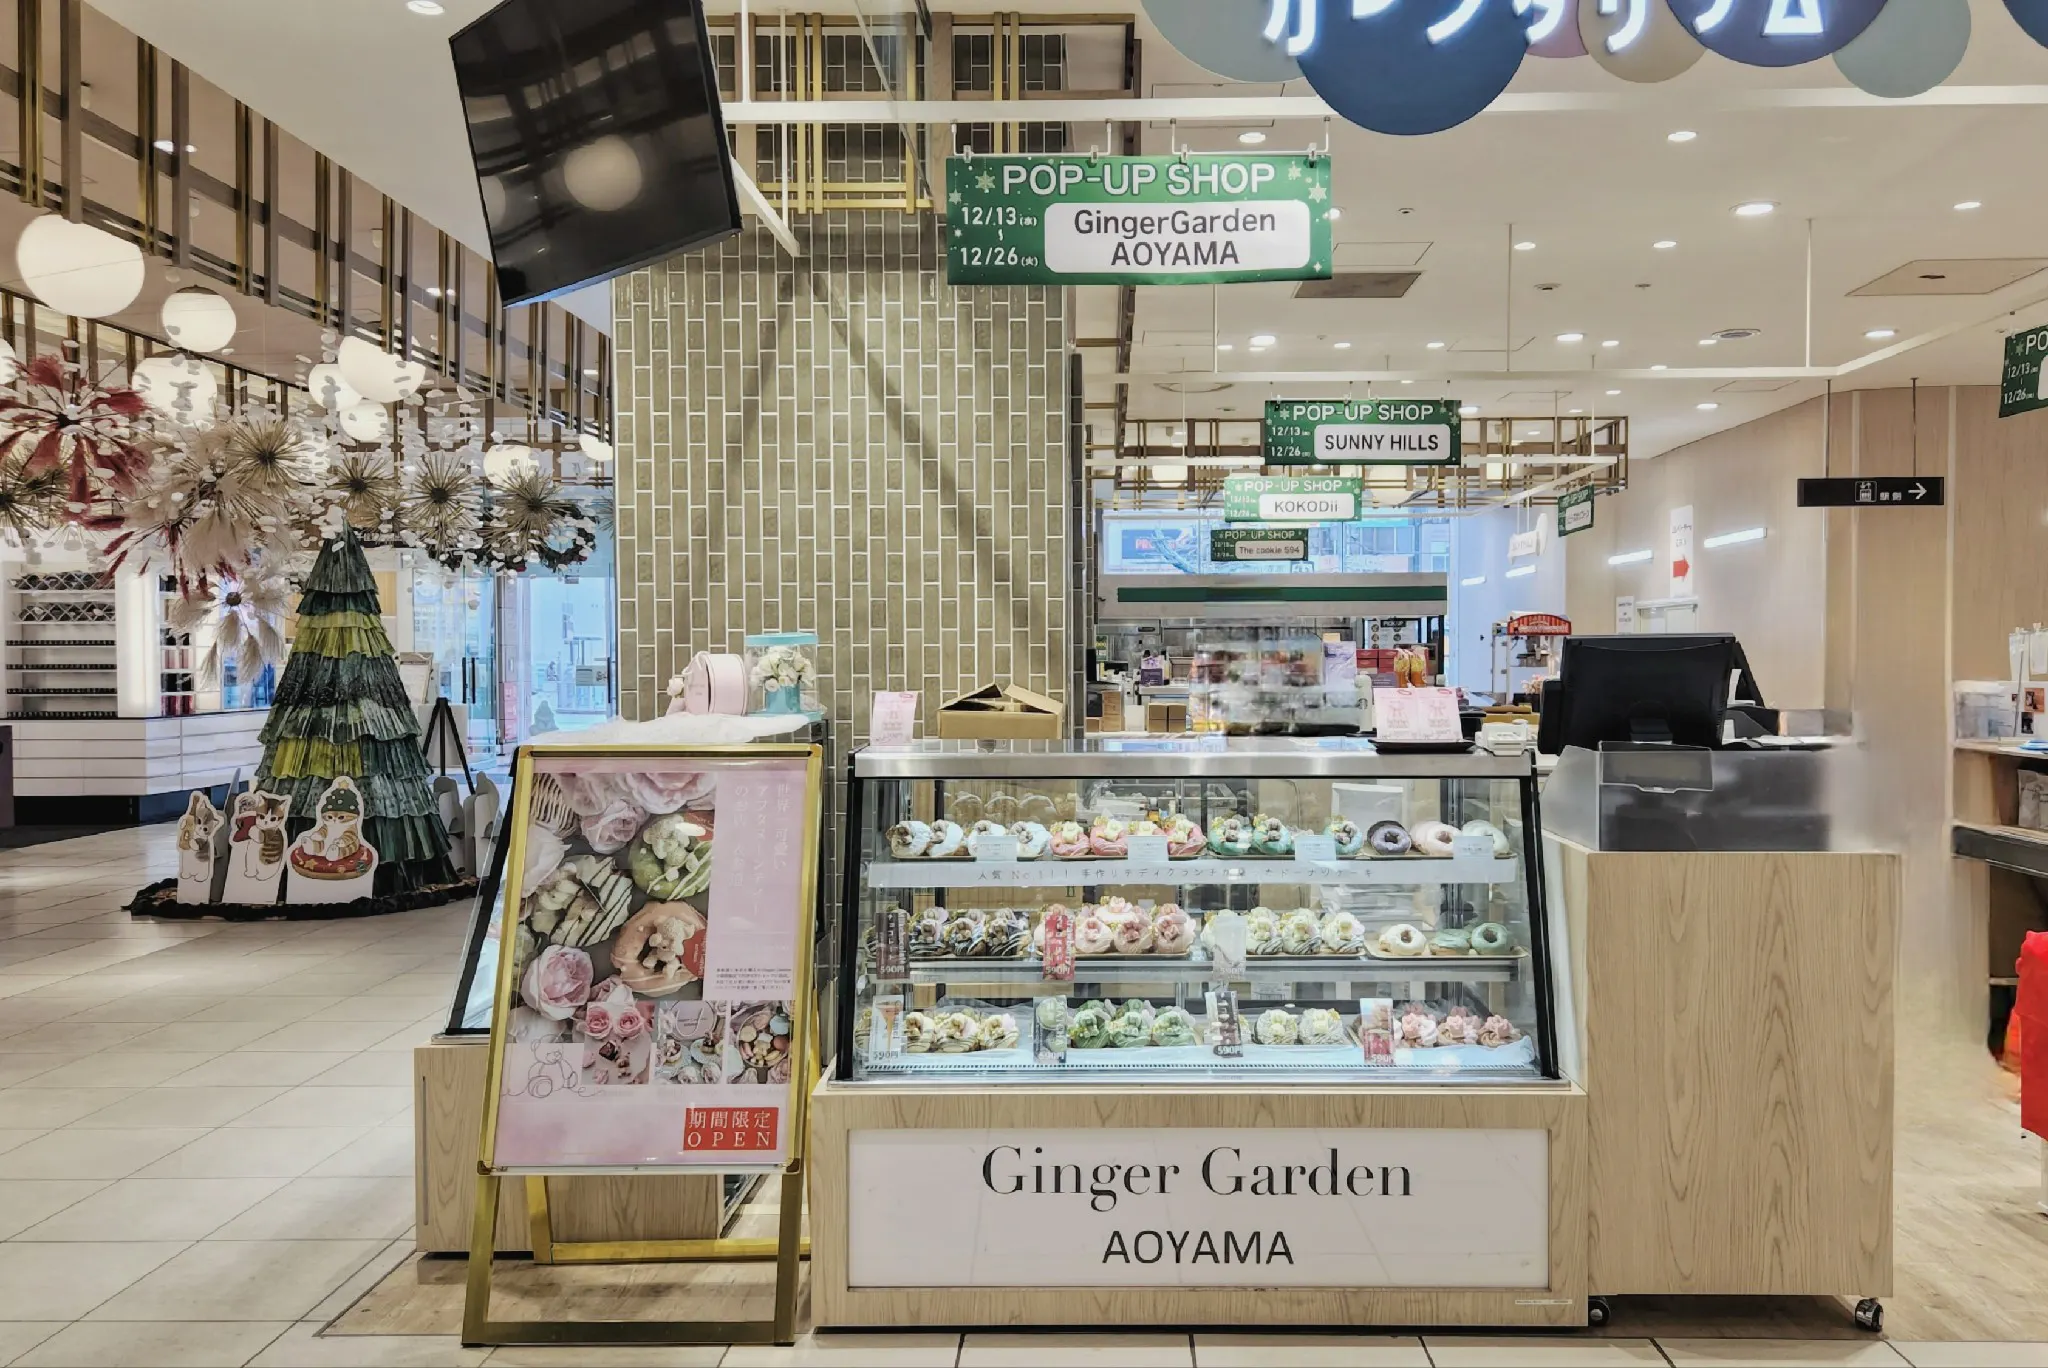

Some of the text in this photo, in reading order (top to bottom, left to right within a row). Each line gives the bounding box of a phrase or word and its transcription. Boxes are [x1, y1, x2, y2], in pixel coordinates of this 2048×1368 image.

[1002, 162, 1276, 196] POP-UP SHOP
[1074, 208, 1277, 239] GingerGarden
[1111, 240, 1241, 268] AOYAMA
[1293, 403, 1434, 421] POP-UP SHOP
[1325, 434, 1439, 451] SUNNY HILLS
[1244, 479, 1343, 493] POP-UP SHOP
[1274, 500, 1339, 513] KOKODii
[1267, 530, 1296, 540] SHOP
[1239, 546, 1254, 555] The
[880, 965, 905, 974] 590円
[688, 1110, 771, 1129] 期間限定
[687, 1131, 771, 1148] OPEN
[982, 1145, 1415, 1212] Ginger Garden
[1102, 1230, 1294, 1265] AOYAMA
